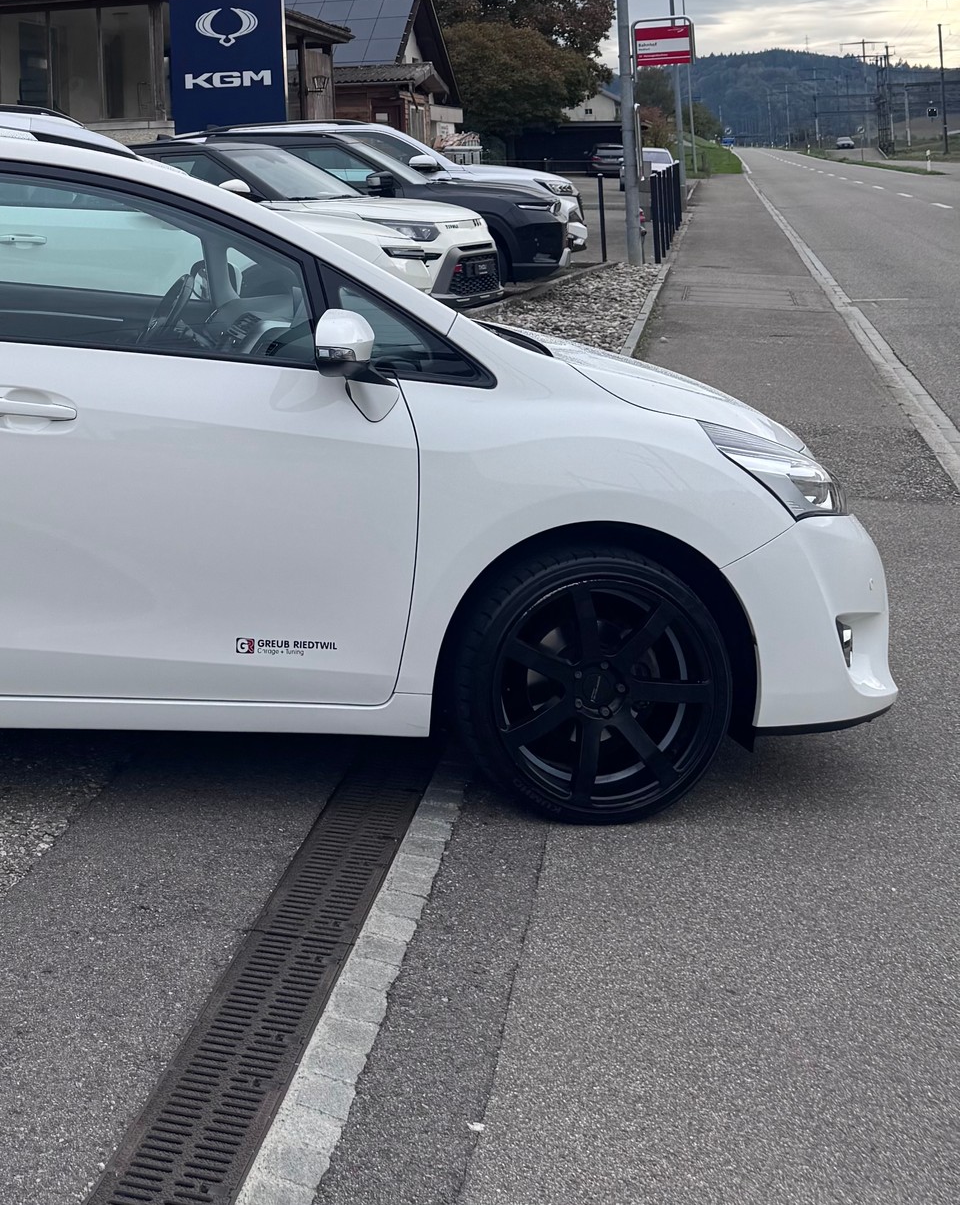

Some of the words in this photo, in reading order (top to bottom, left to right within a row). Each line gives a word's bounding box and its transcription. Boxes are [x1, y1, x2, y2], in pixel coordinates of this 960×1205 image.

[184, 69, 272, 90] KGM
[257, 639, 290, 648] GREUB
[293, 641, 338, 650] RIEDTWIL
